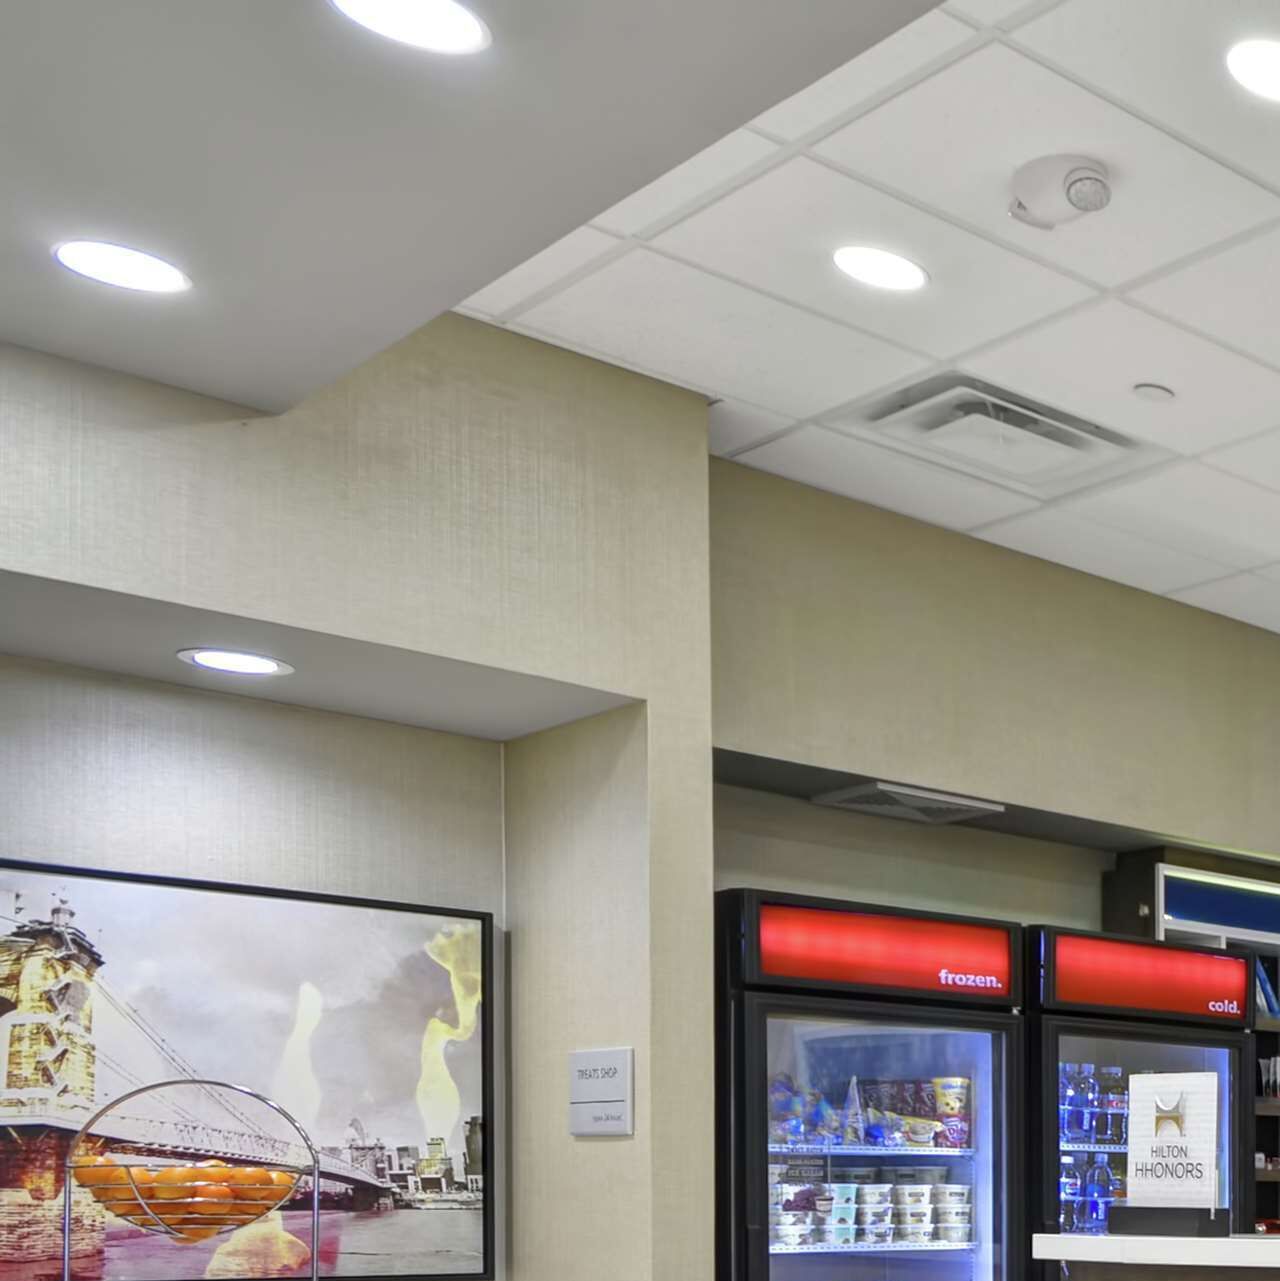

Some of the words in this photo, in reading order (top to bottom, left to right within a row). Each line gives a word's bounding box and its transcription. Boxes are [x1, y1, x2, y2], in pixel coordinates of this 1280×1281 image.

[938, 968, 1003, 988] frozen.
[1208, 1000, 1241, 1014] cold.
[1150, 1145, 1188, 1159] HILTON
[1134, 1161, 1204, 1179] HHONORS
